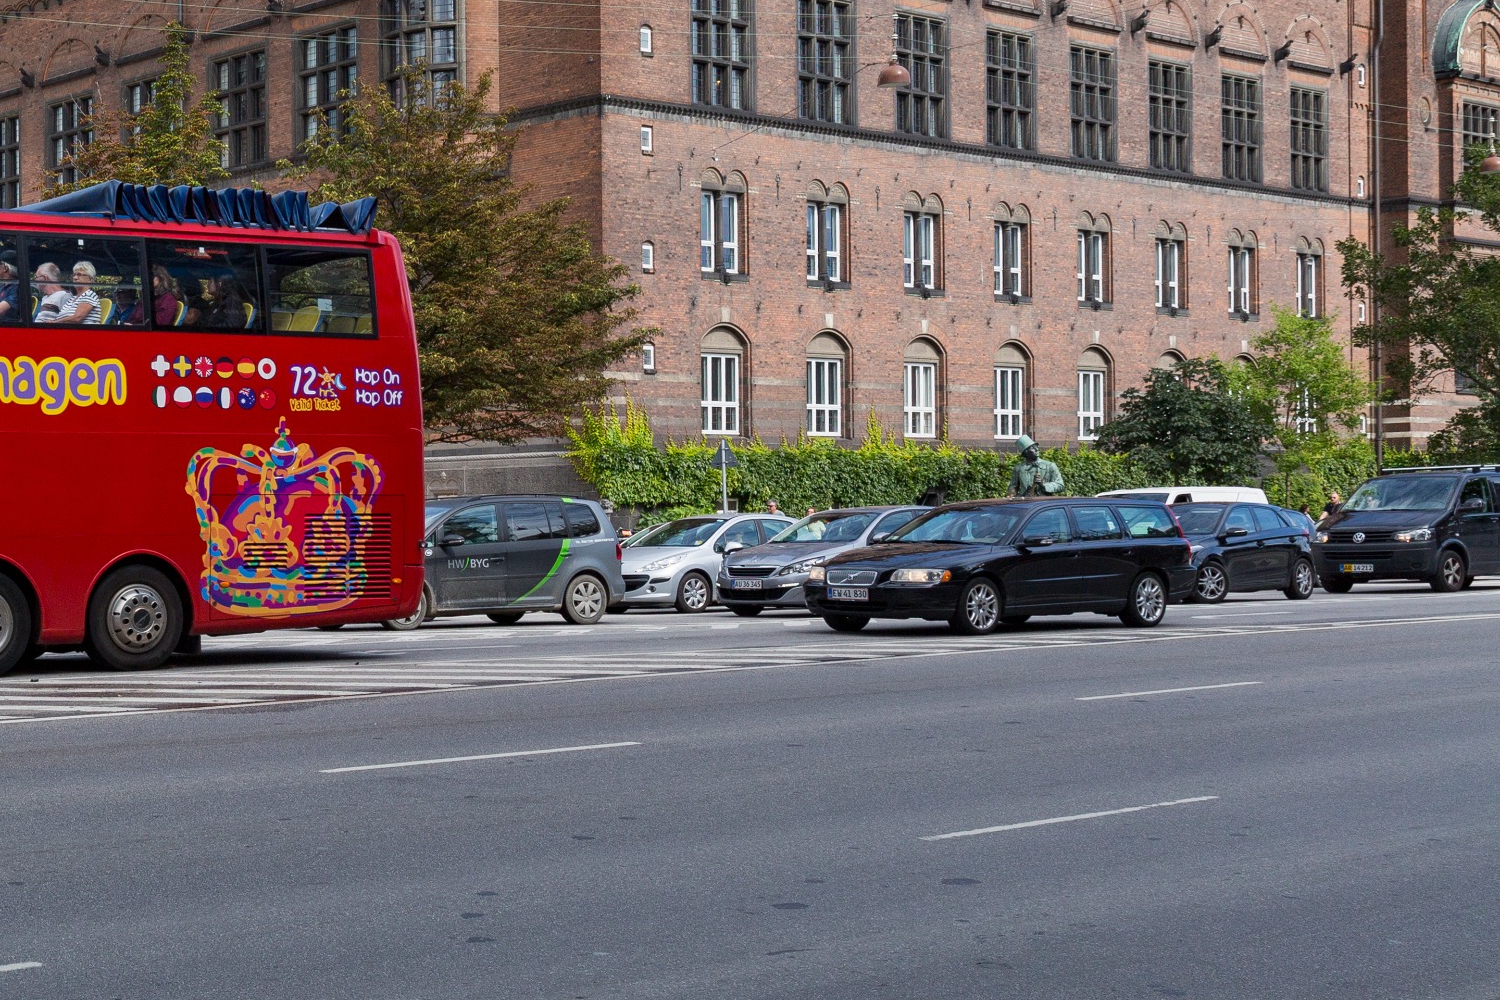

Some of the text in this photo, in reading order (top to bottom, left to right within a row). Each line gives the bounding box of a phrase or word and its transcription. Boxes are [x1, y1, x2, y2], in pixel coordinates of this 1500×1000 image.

[290, 366, 317, 395] 72
[355, 368, 400, 386] Hop On
[290, 397, 341, 411] Valid Ticket
[356, 389, 403, 406] Hop Off
[832, 589, 867, 598] EW 41 830
